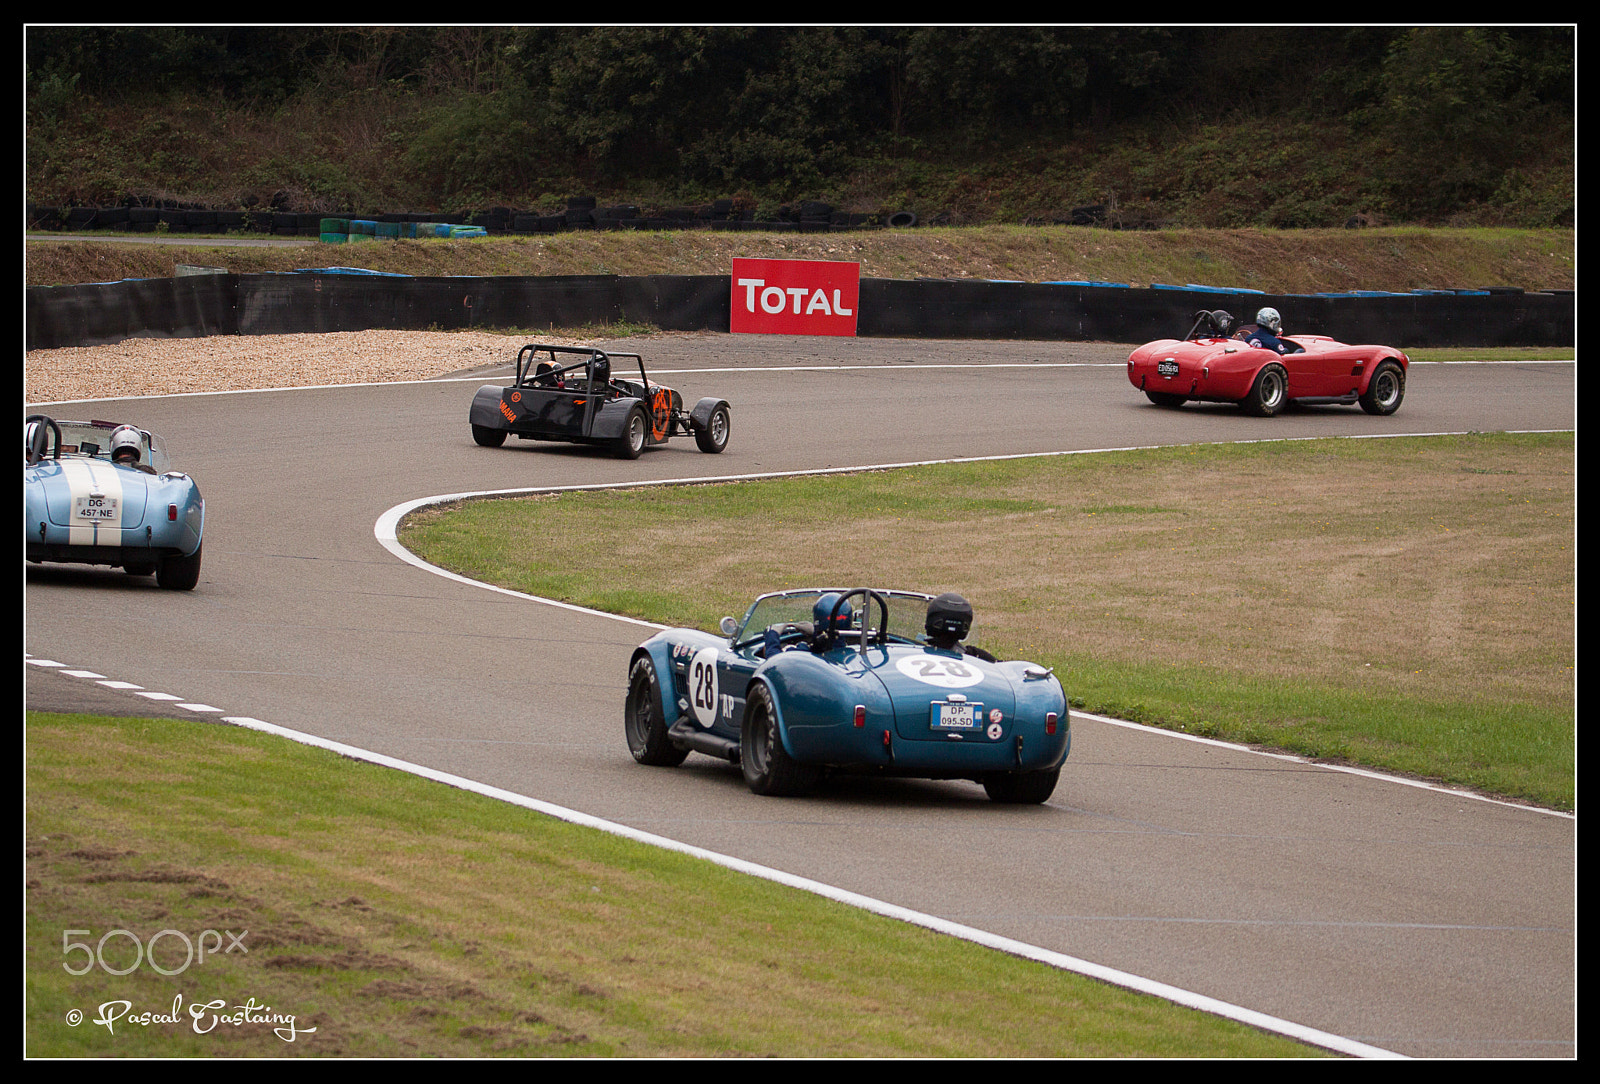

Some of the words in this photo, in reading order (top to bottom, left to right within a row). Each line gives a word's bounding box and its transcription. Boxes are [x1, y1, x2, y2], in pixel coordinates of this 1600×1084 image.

[738, 278, 853, 316] TOTAL
[695, 661, 714, 711] 28
[911, 659, 973, 678] 28
